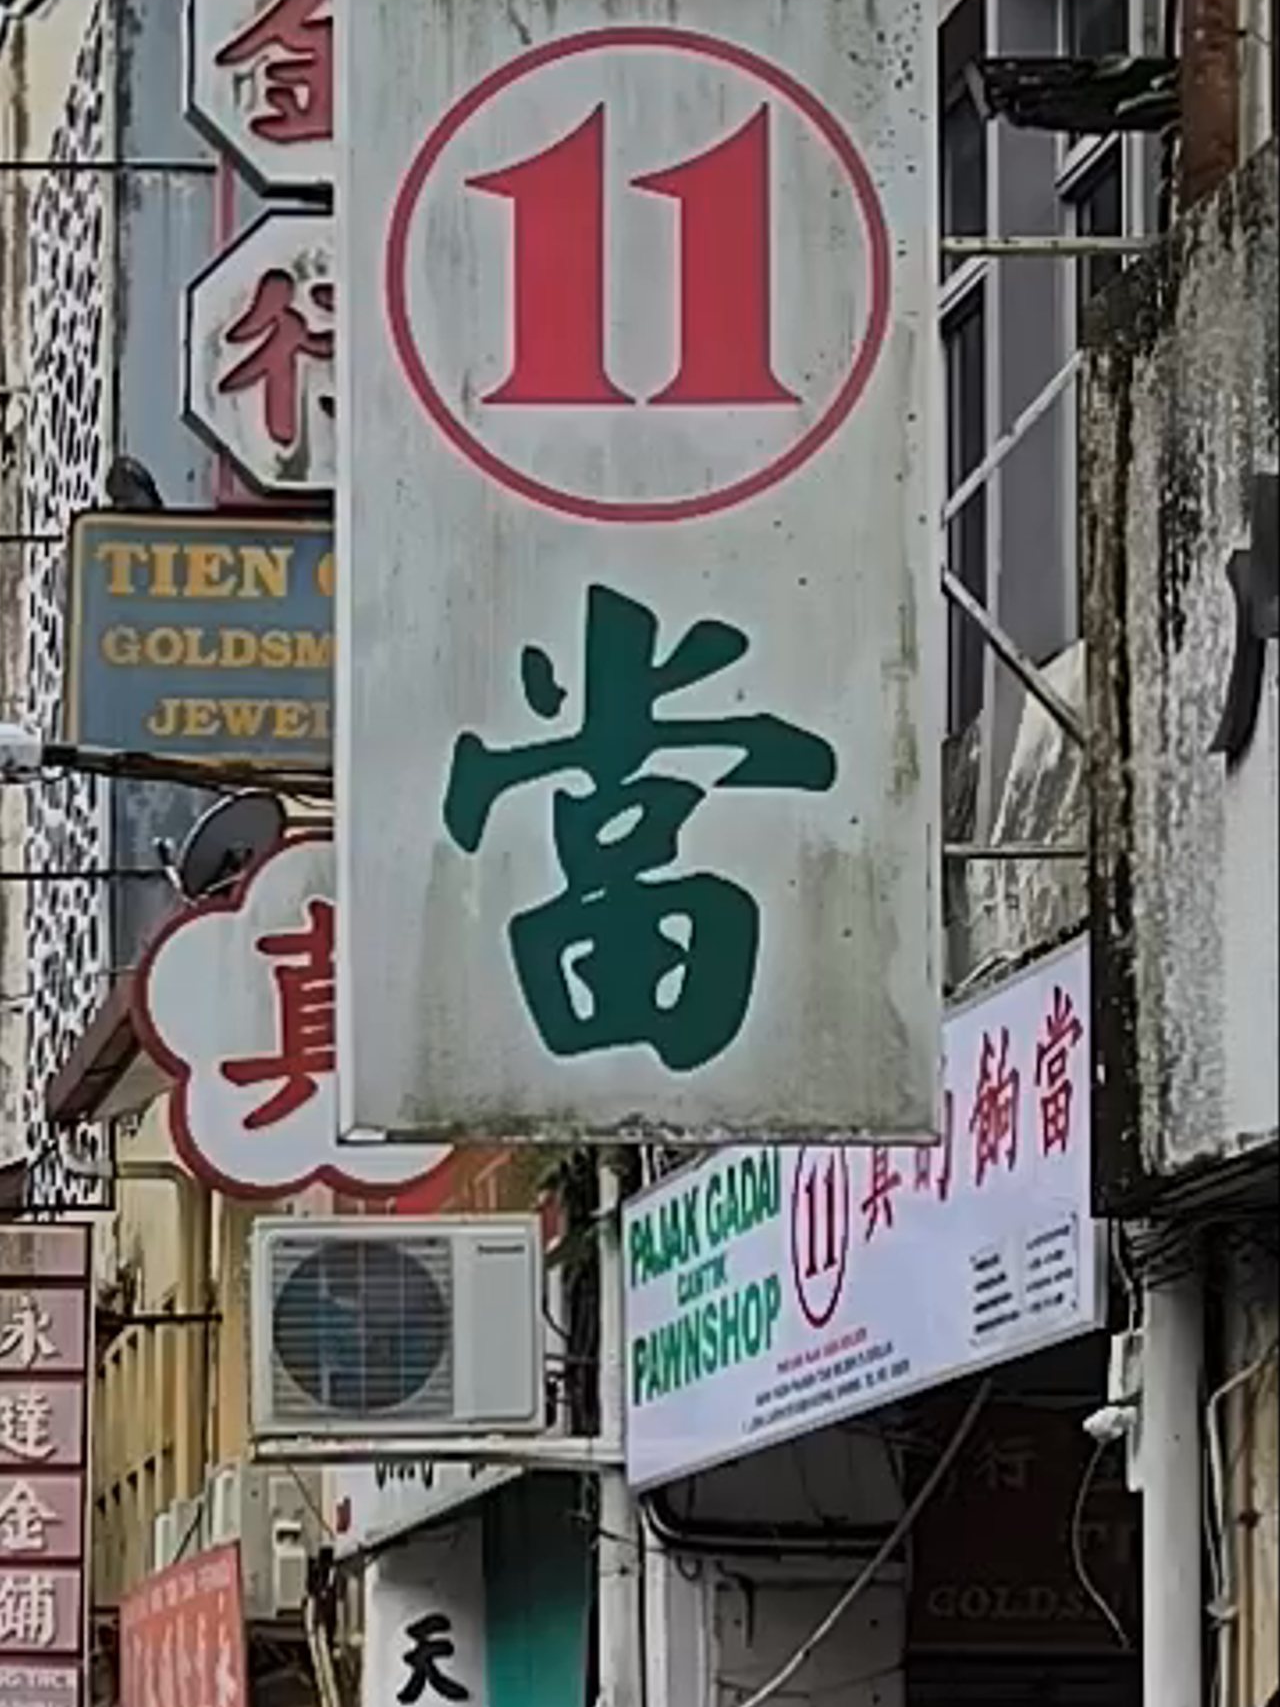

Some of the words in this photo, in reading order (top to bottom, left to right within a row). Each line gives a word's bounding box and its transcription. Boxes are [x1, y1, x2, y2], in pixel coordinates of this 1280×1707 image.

[464, 101, 804, 406] 11
[96, 542, 294, 597] TIEN
[101, 626, 334, 669] GOLDSM
[442, 581, 838, 1073] 當
[630, 1186, 700, 1290] PAJAK
[706, 1146, 781, 1246] GADAI
[632, 1274, 782, 1407] PAWNSHOP
